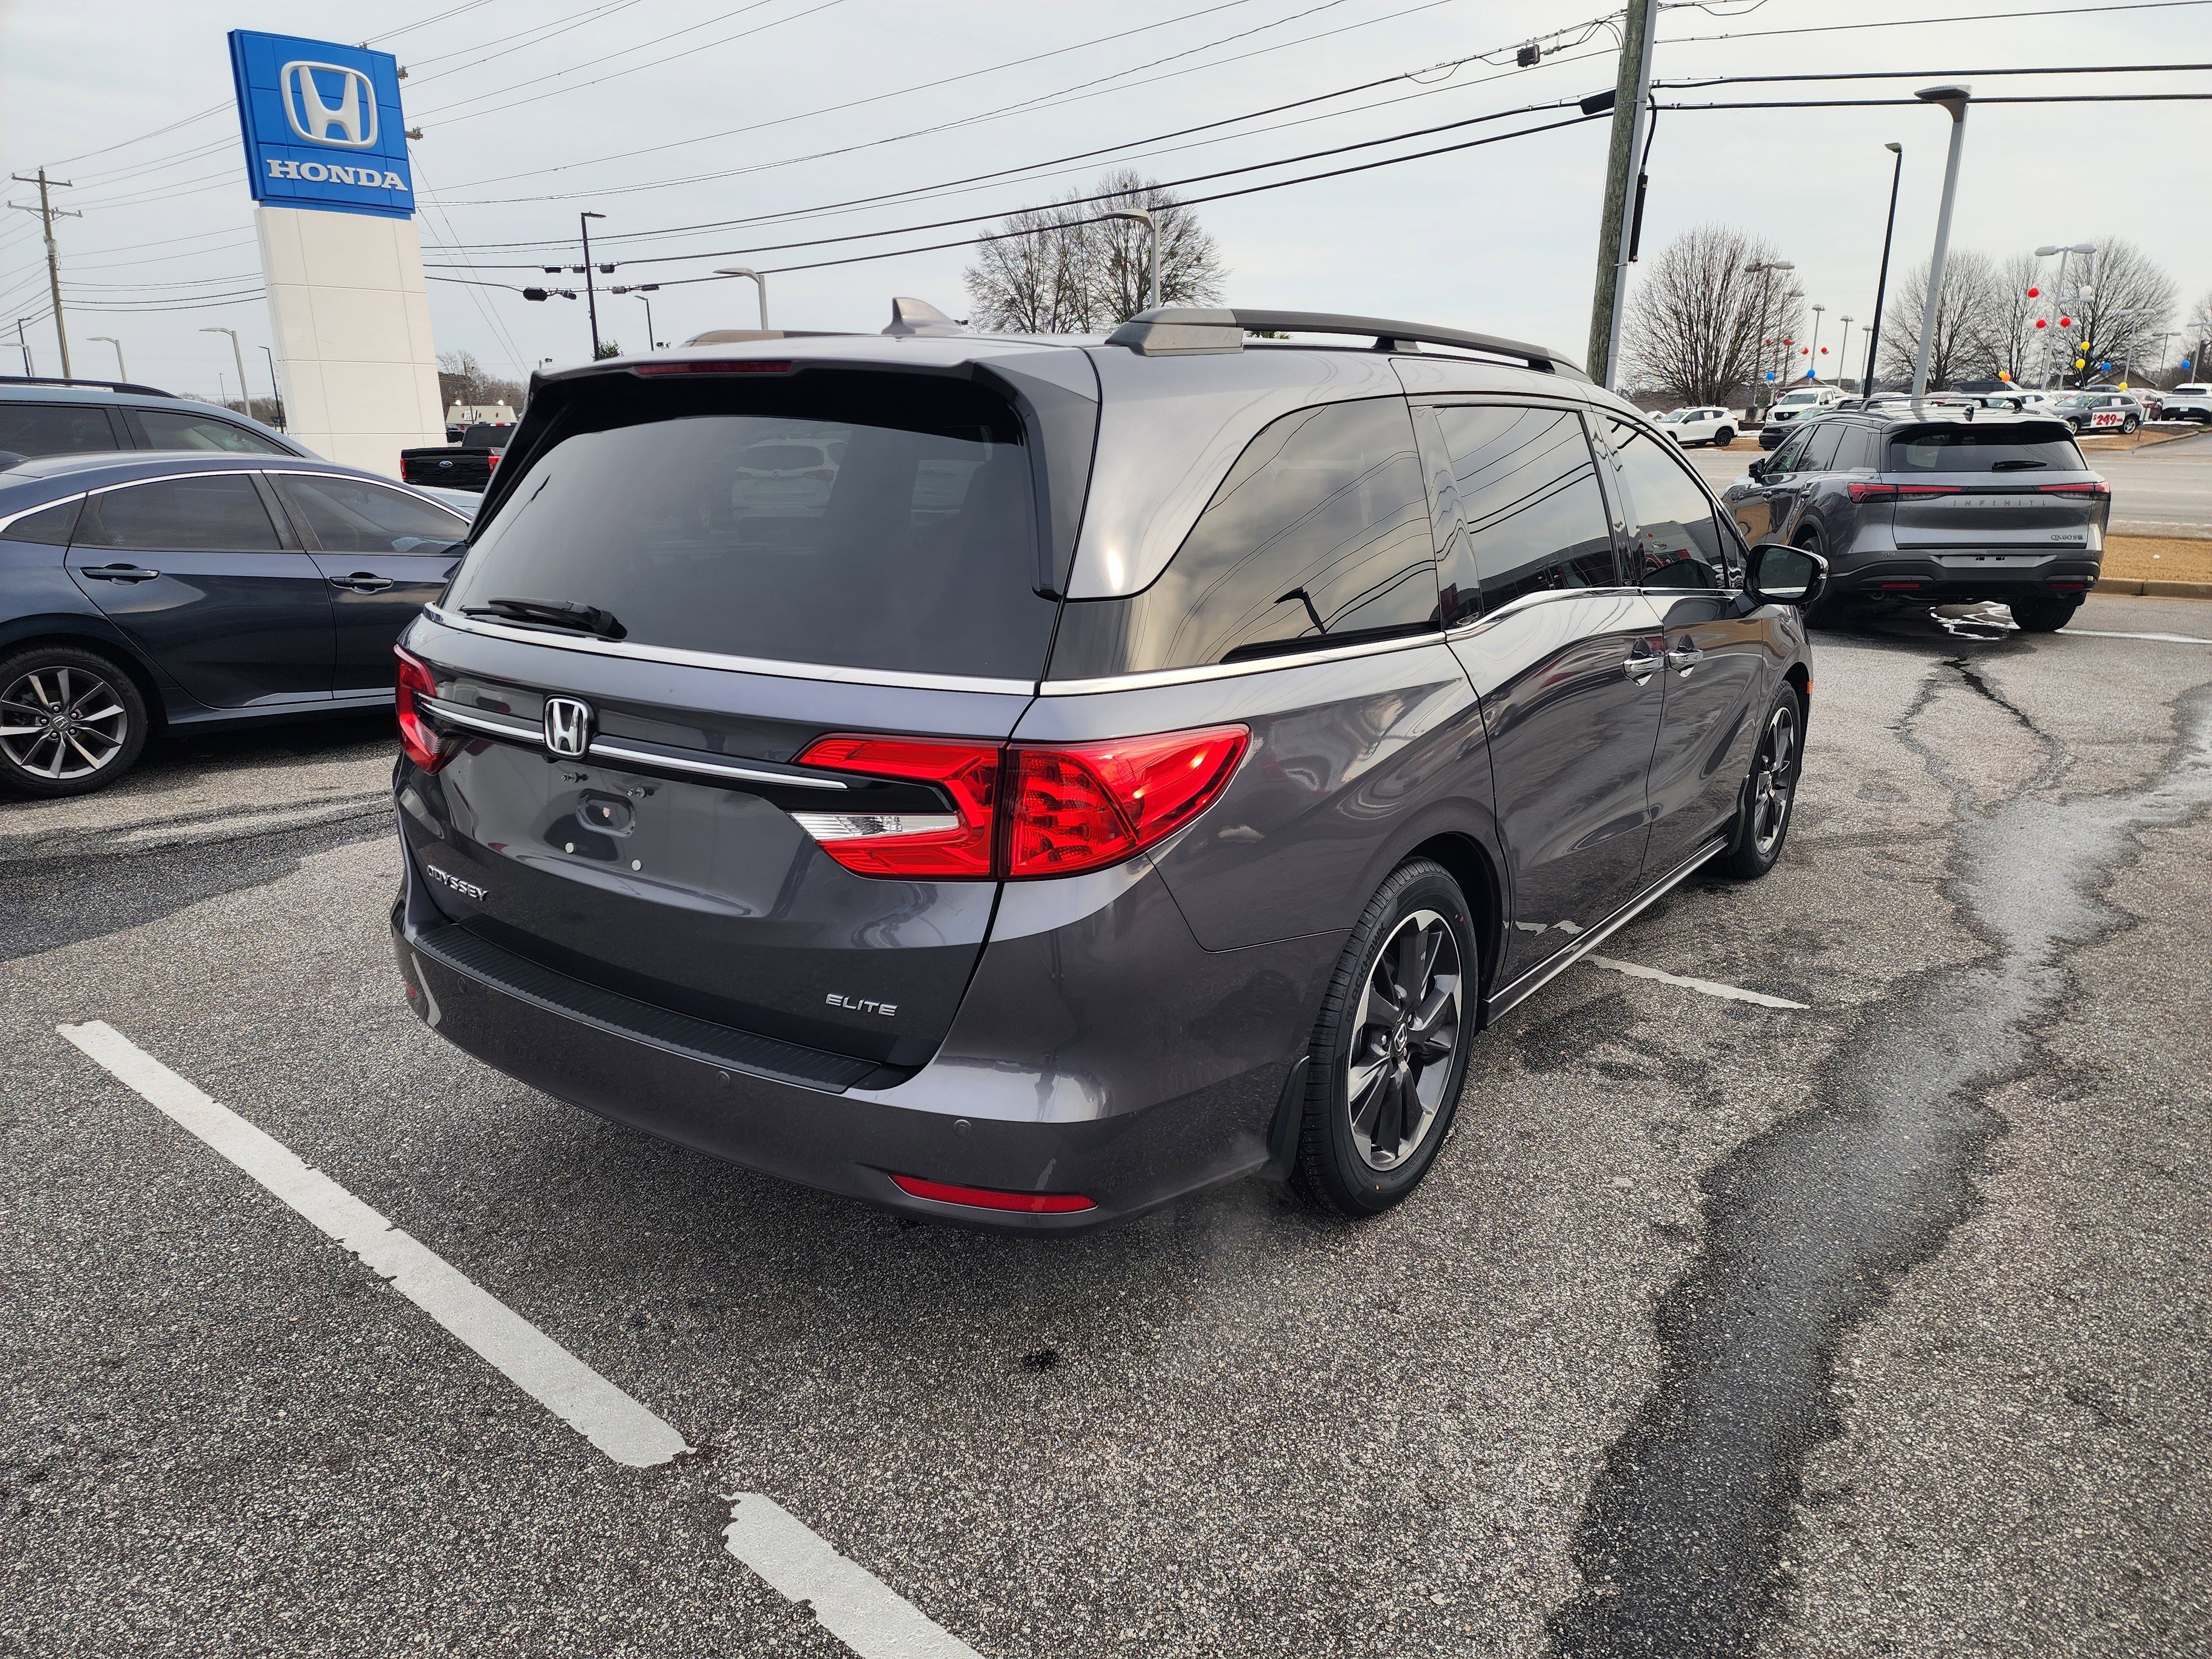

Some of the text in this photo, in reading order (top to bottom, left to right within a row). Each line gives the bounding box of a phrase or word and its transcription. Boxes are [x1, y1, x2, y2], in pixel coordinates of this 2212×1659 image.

[266, 159, 408, 191] HONDA
[2093, 414, 2117, 425] $249
[427, 864, 489, 901] ODYSSEY
[826, 993, 899, 1017] ELITE
